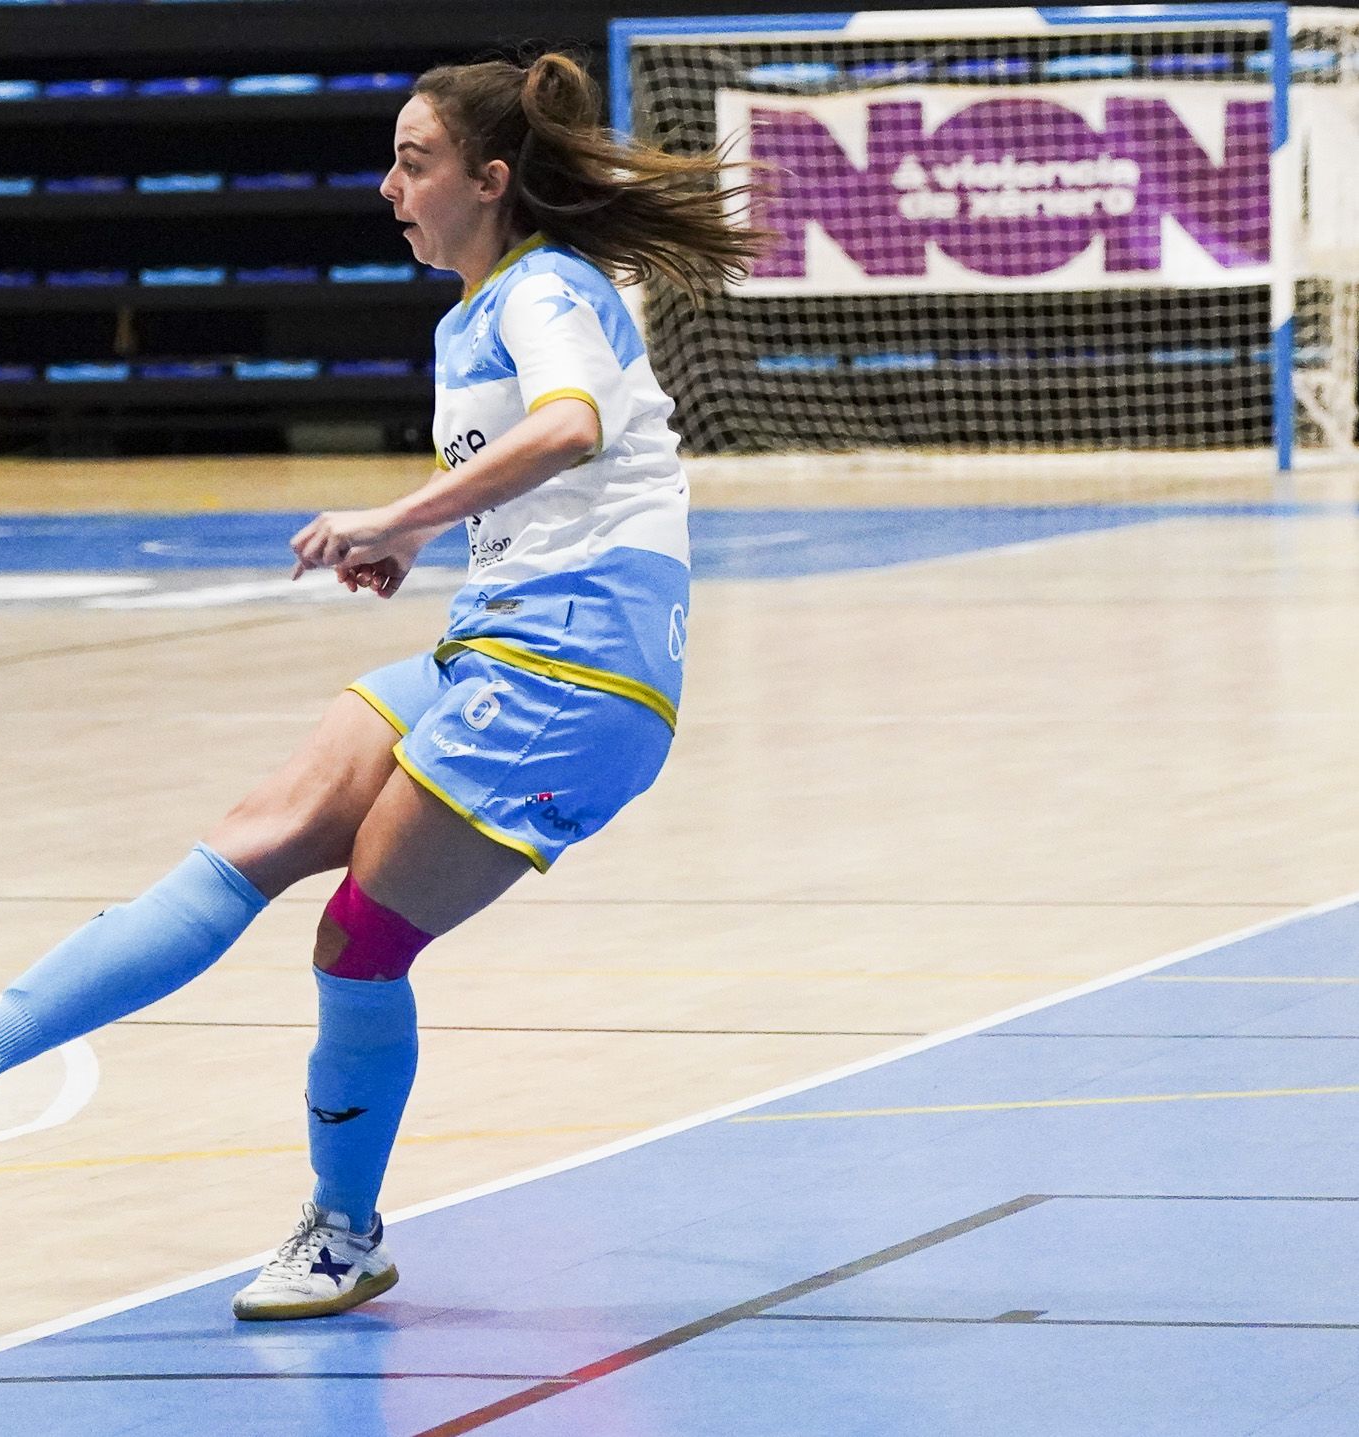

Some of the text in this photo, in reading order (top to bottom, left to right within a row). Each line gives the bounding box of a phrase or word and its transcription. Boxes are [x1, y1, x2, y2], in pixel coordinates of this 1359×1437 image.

[751, 97, 1270, 278] NON
[934, 154, 1140, 190] violencia
[898, 187, 958, 220] de
[461, 680, 514, 732] 6
